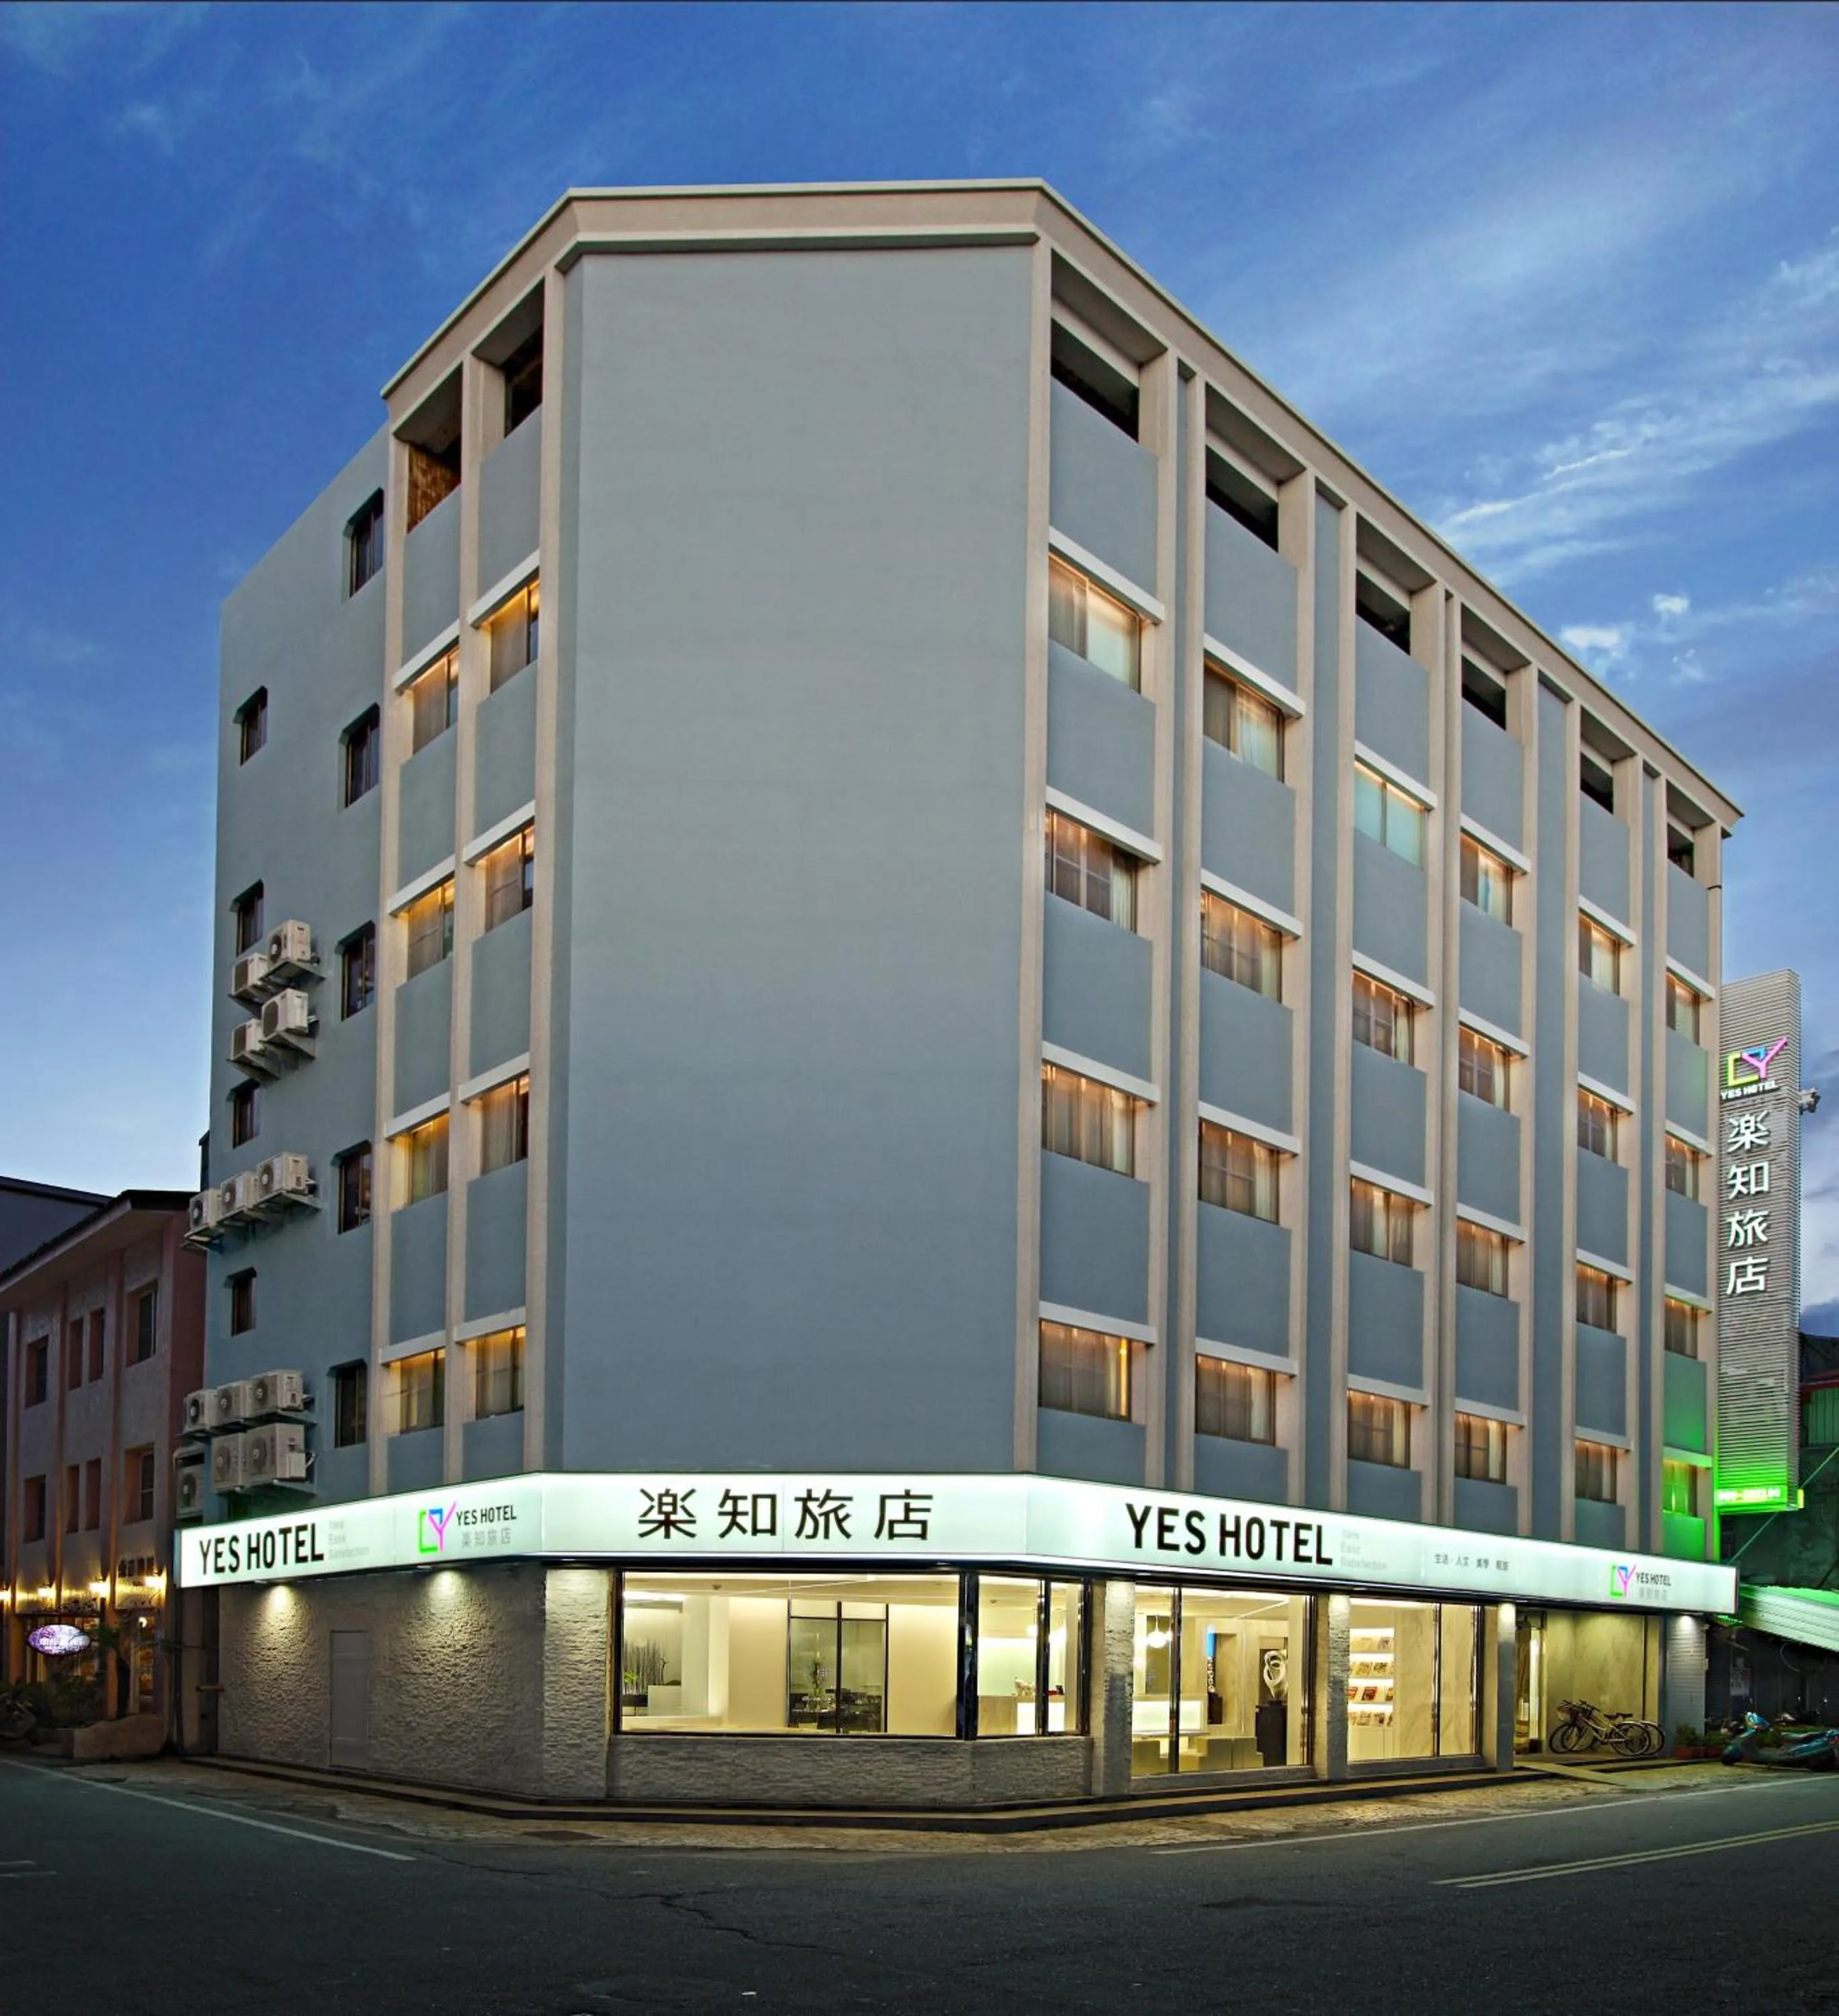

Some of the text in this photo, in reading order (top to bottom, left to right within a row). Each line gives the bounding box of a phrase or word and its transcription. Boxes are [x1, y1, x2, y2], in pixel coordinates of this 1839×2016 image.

[1721, 1081, 1778, 1100] YES HOTEL
[456, 1505, 517, 1527] YES HOTEL
[637, 1488, 934, 1541] 楽知旅店
[199, 1534, 240, 1576] YES
[247, 1523, 325, 1570] HOTEL
[1126, 1503, 1334, 1566] YES HOTEL
[1635, 1571, 1672, 1587] YES HOTEL
